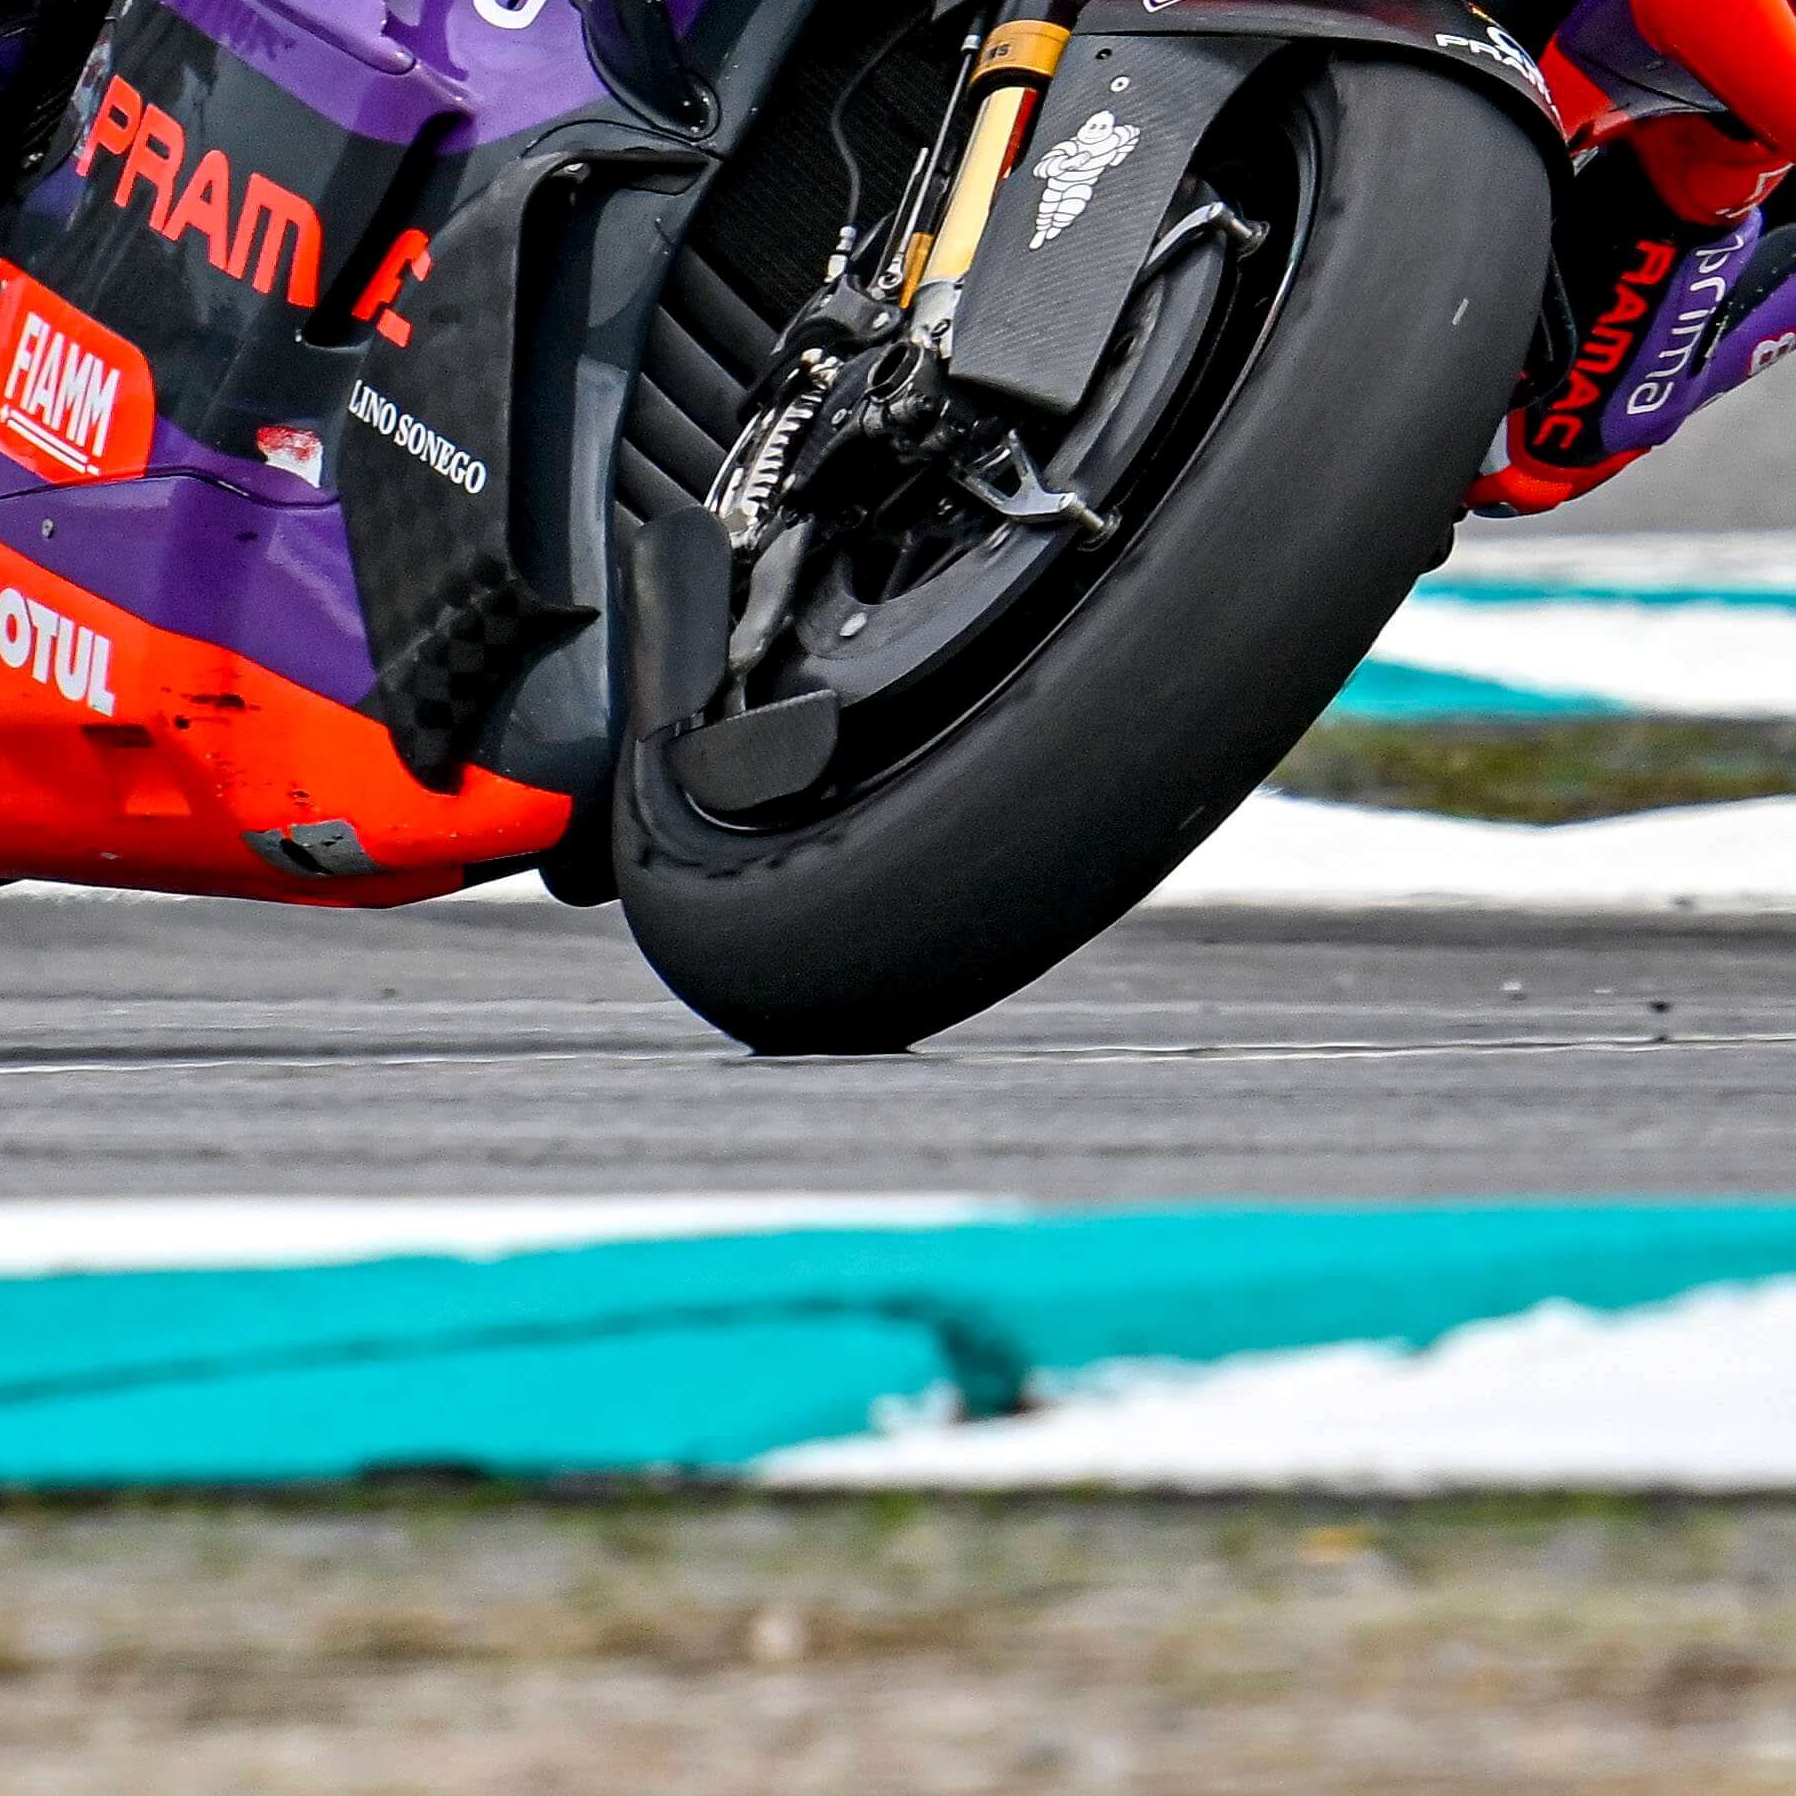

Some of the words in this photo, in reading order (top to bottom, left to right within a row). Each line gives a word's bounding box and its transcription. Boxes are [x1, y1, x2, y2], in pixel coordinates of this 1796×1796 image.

[4, 310, 122, 458] FIAMM
[1625, 234, 1745, 417] prima
[348, 378, 397, 437] LINO
[393, 414, 490, 496] SONEGO
